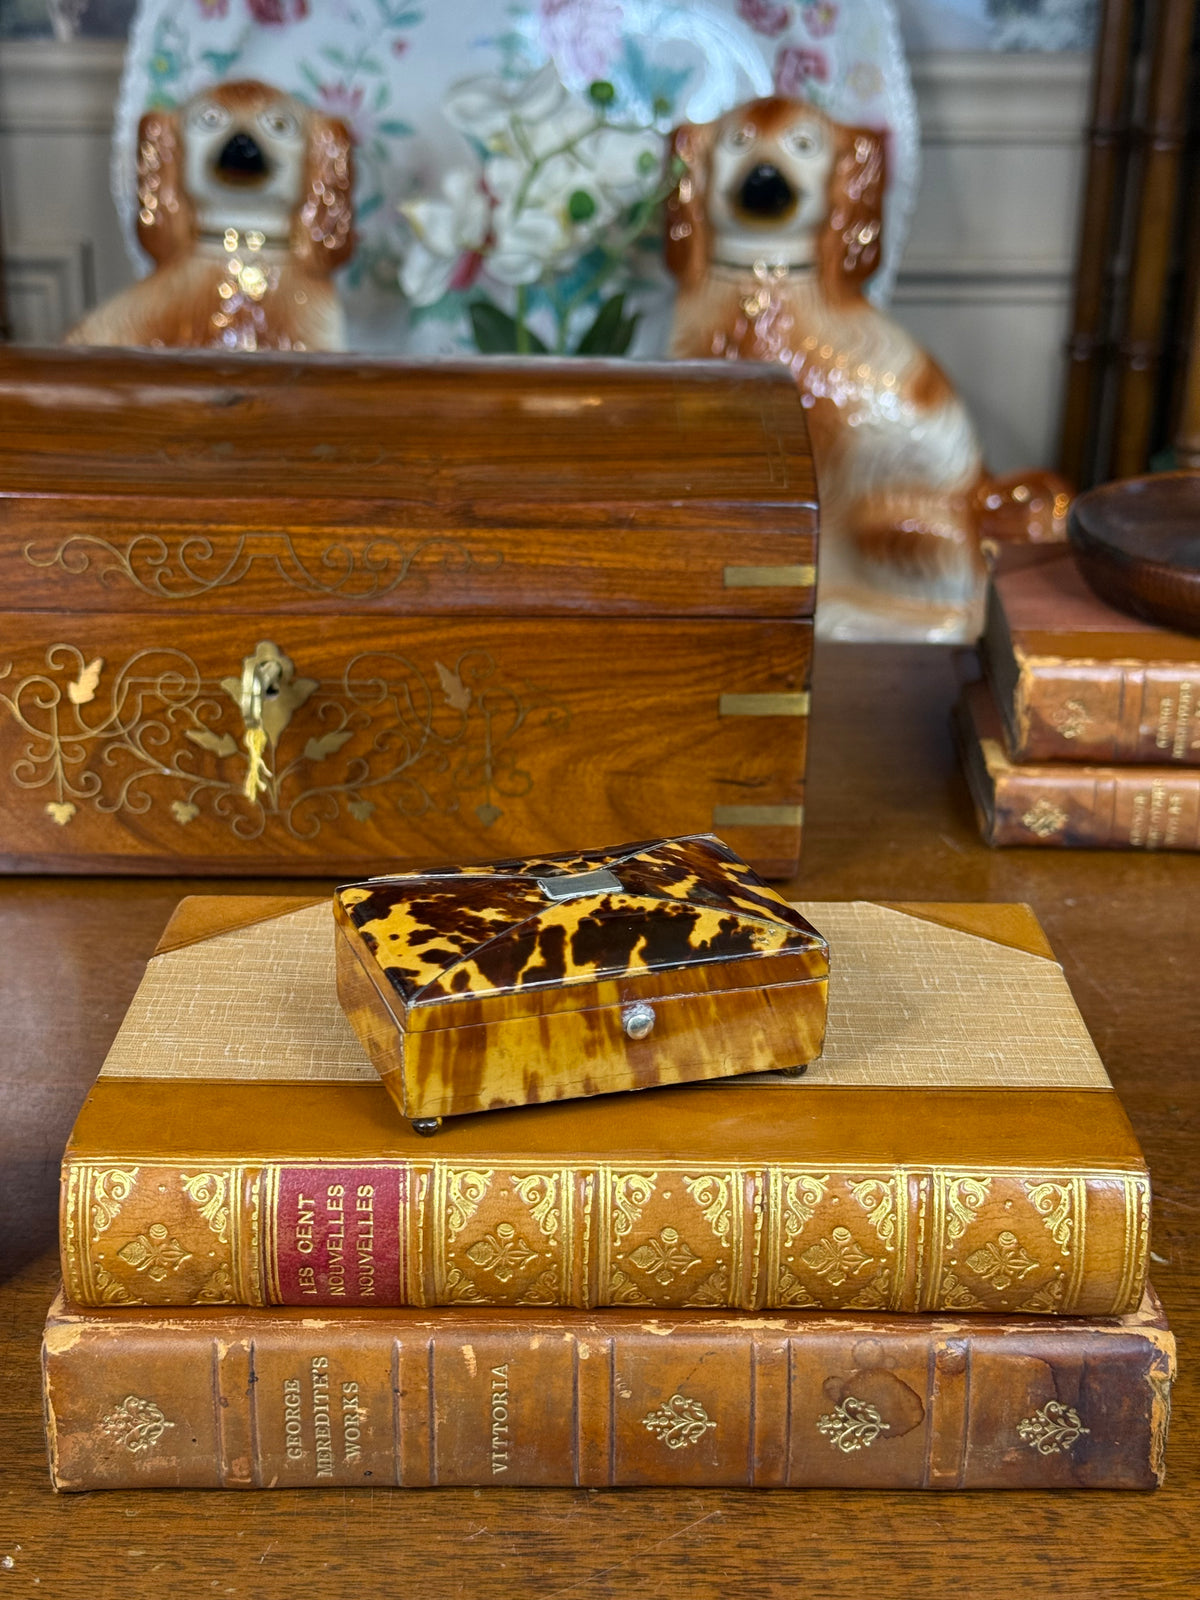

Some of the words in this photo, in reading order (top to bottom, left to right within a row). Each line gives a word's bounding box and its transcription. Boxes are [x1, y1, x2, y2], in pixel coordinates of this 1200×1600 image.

[296, 1193, 316, 1254] CENT
[326, 1184, 346, 1296] NOUVELLES
[356, 1184, 376, 1296] NOUVELLES
[299, 1266, 318, 1294] LES
[284, 1379, 303, 1460] GEORGE
[311, 1356, 334, 1478] MEREDITH'S
[342, 1381, 361, 1460] WORKS
[491, 1363, 509, 1475] VITTORIA
